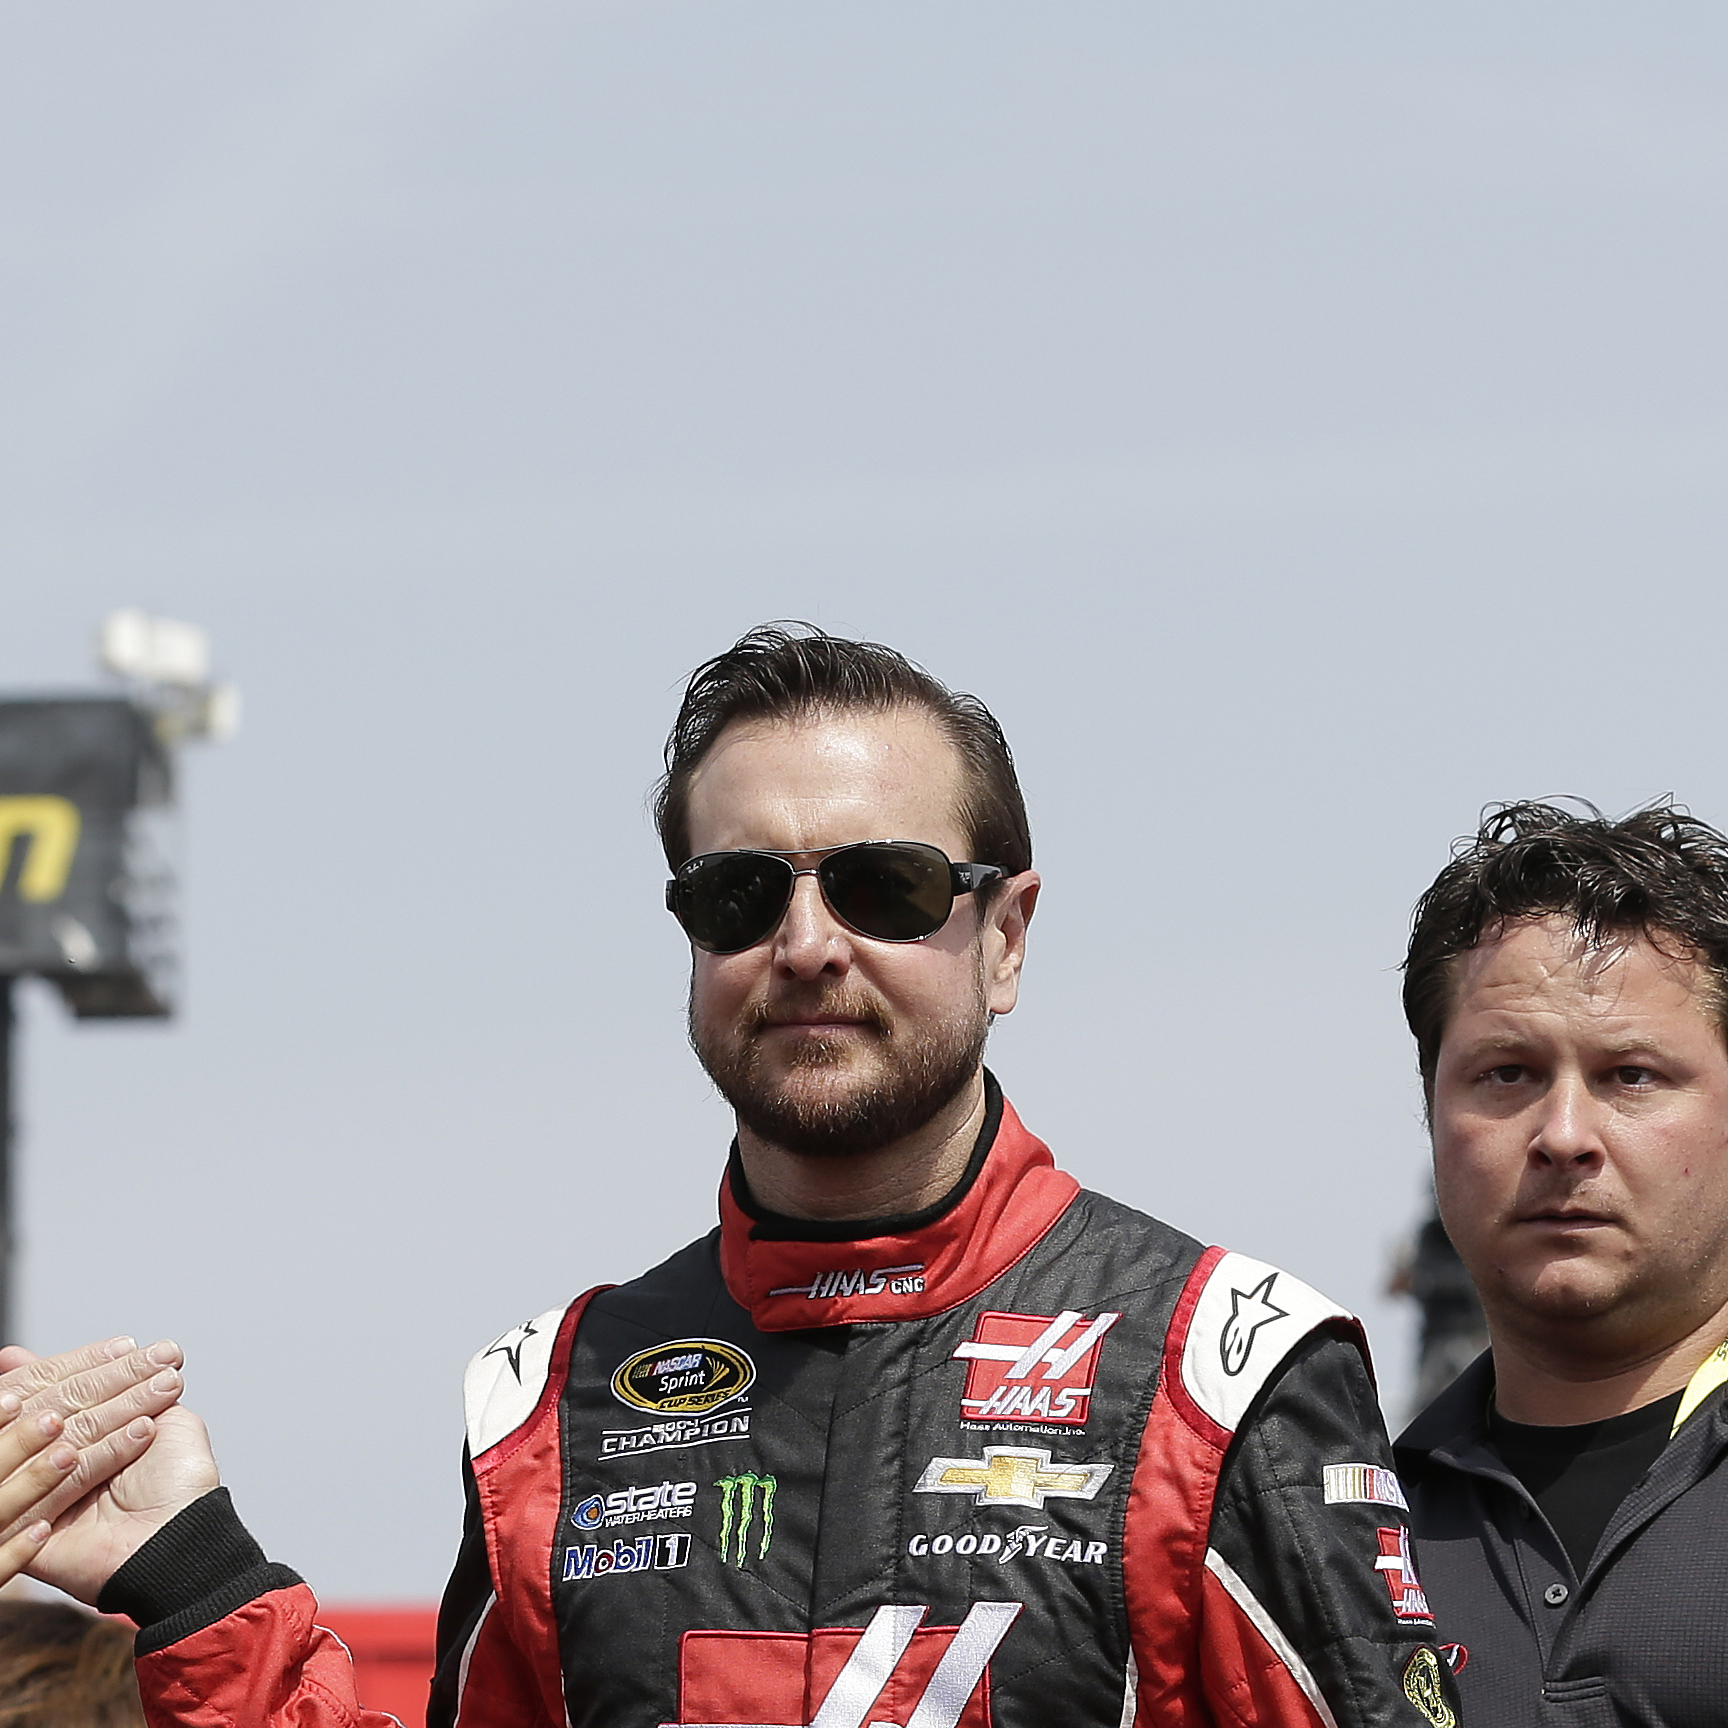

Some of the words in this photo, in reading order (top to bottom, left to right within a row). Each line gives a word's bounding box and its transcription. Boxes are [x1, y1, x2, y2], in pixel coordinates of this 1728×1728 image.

[767, 1264, 925, 1299] HAAS
[890, 1276, 925, 1294] CNC
[653, 1353, 704, 1376] NASCAR
[659, 1370, 706, 1393] Sprint
[961, 1386, 1091, 1417] HAAS
[602, 1415, 750, 1453] CHAMPION
[604, 1480, 697, 1515] state
[562, 1535, 654, 1581] Mobil
[908, 1526, 1108, 1565] GOODYEAR
